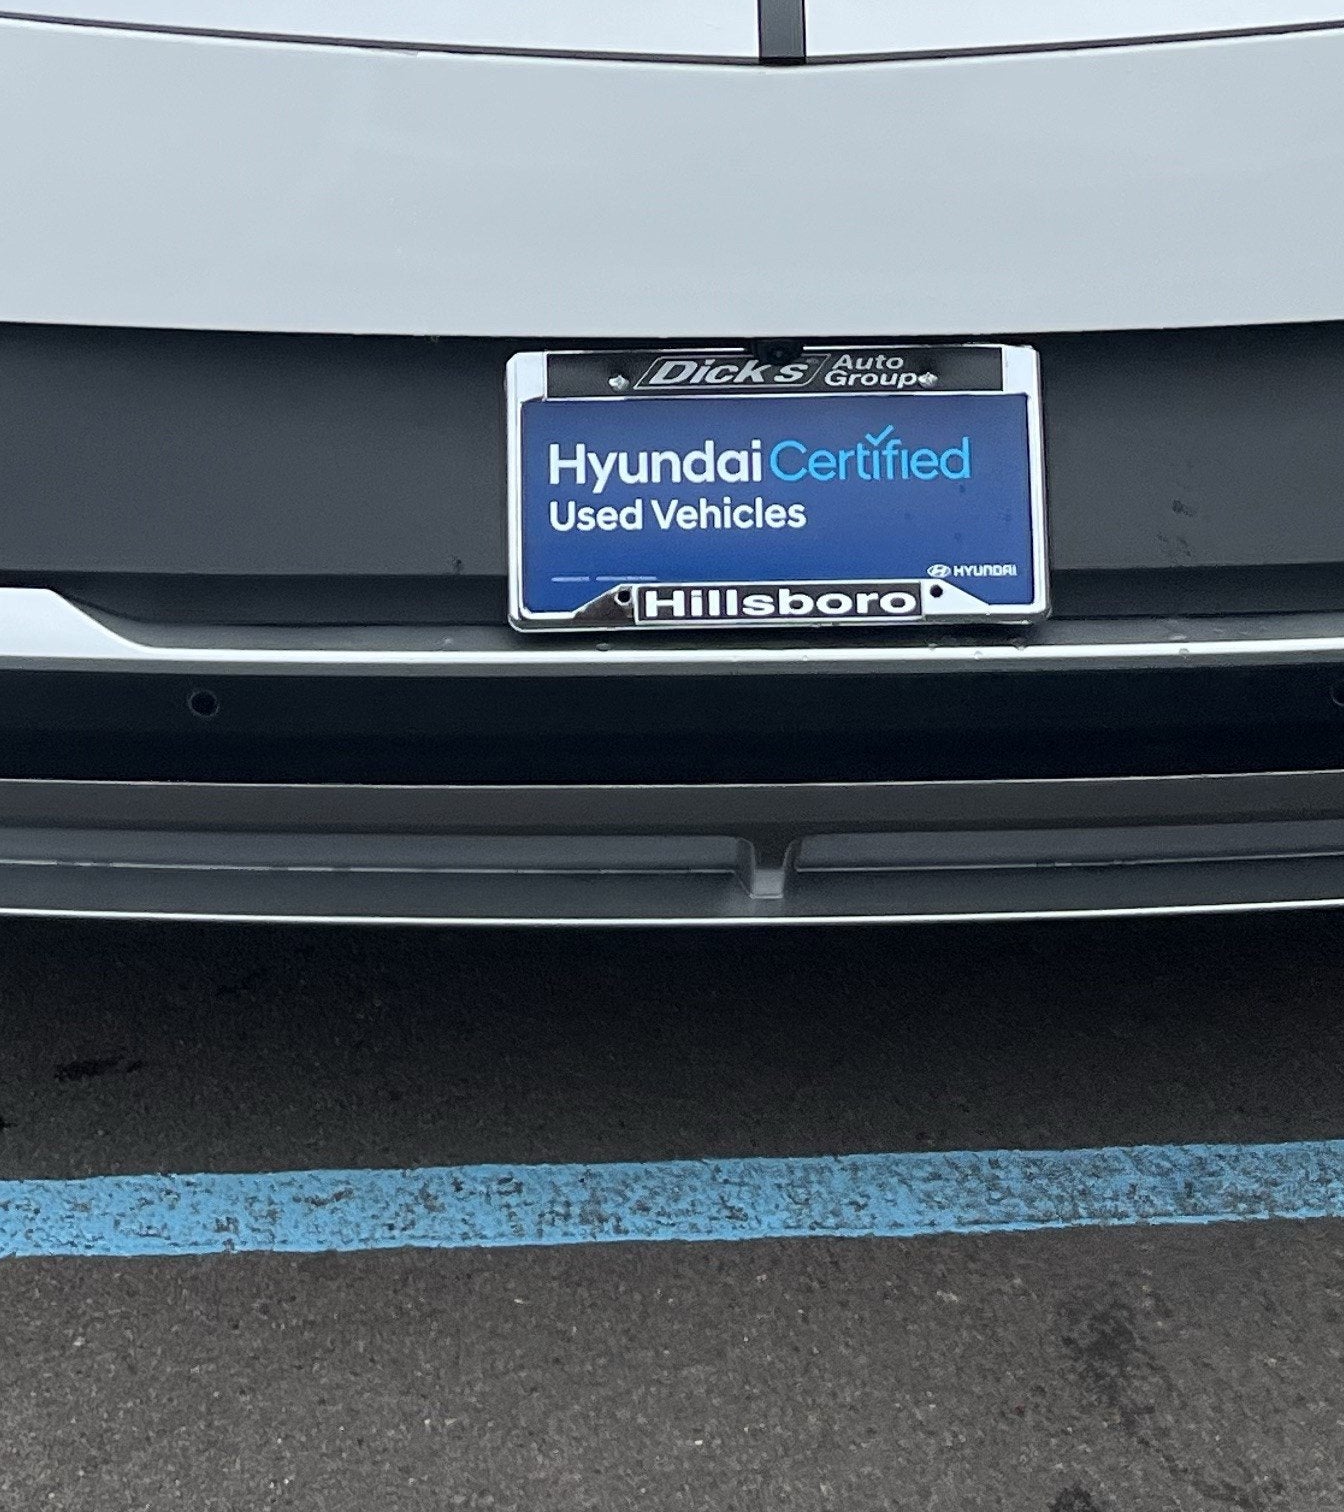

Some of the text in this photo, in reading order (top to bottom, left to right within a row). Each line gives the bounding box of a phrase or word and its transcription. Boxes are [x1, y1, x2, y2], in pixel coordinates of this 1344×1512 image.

[649, 358, 809, 385] Dicks
[831, 354, 904, 371] Auto
[824, 369, 918, 389] Group
[548, 425, 971, 494] Hyundai Certified
[549, 496, 807, 532] Used Vehicles
[953, 564, 1018, 577] HYUNDAI
[644, 588, 917, 618] Hillsboro
